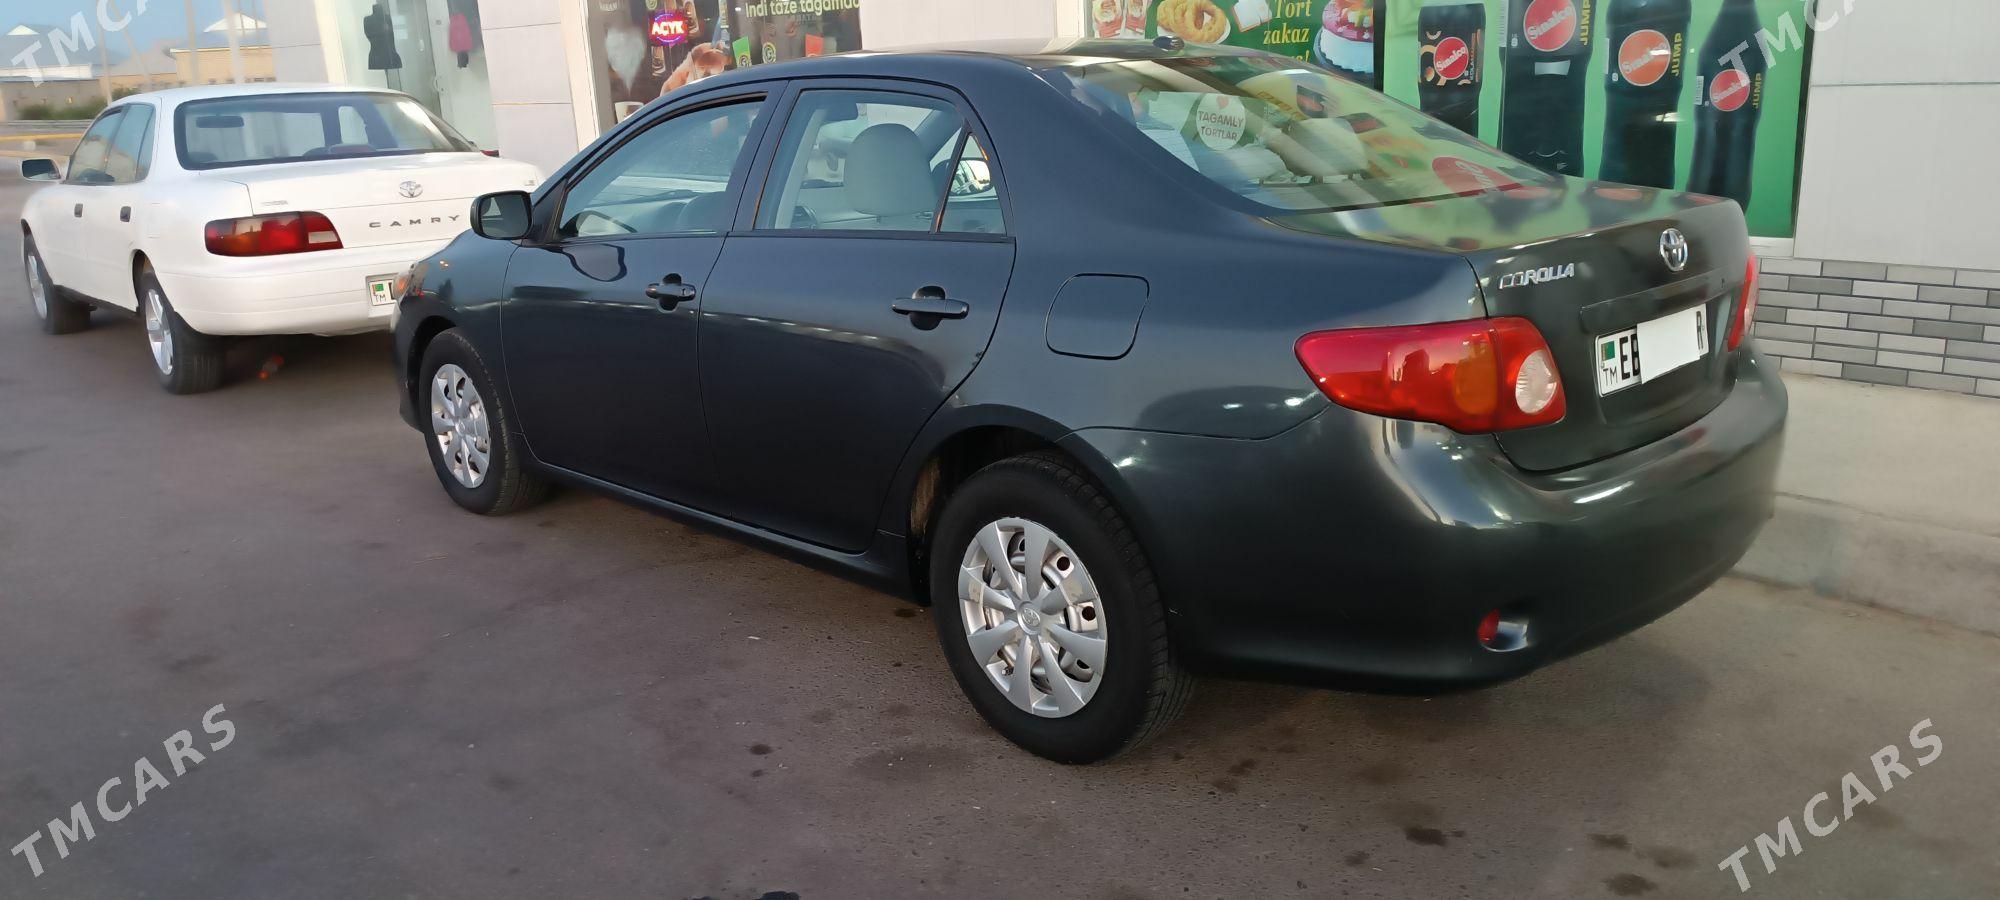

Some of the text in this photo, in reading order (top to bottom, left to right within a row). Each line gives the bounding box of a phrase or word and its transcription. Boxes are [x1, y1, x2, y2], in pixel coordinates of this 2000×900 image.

[1275, 0, 1312, 18] Tort
[1263, 23, 1310, 45] zakaz
[1579, 0, 1591, 46] JUMP
[1436, 46, 1466, 71] Sinalco
[1671, 33, 1682, 76] JUMP
[1753, 73, 1762, 109] JUMP
[1198, 110, 1244, 127] TAGAMLY
[1201, 126, 1237, 141] TORTLAR
[369, 214, 459, 228] CAMRY
[1499, 262, 1574, 290] COROLLA
[1603, 366, 1618, 386] TM
